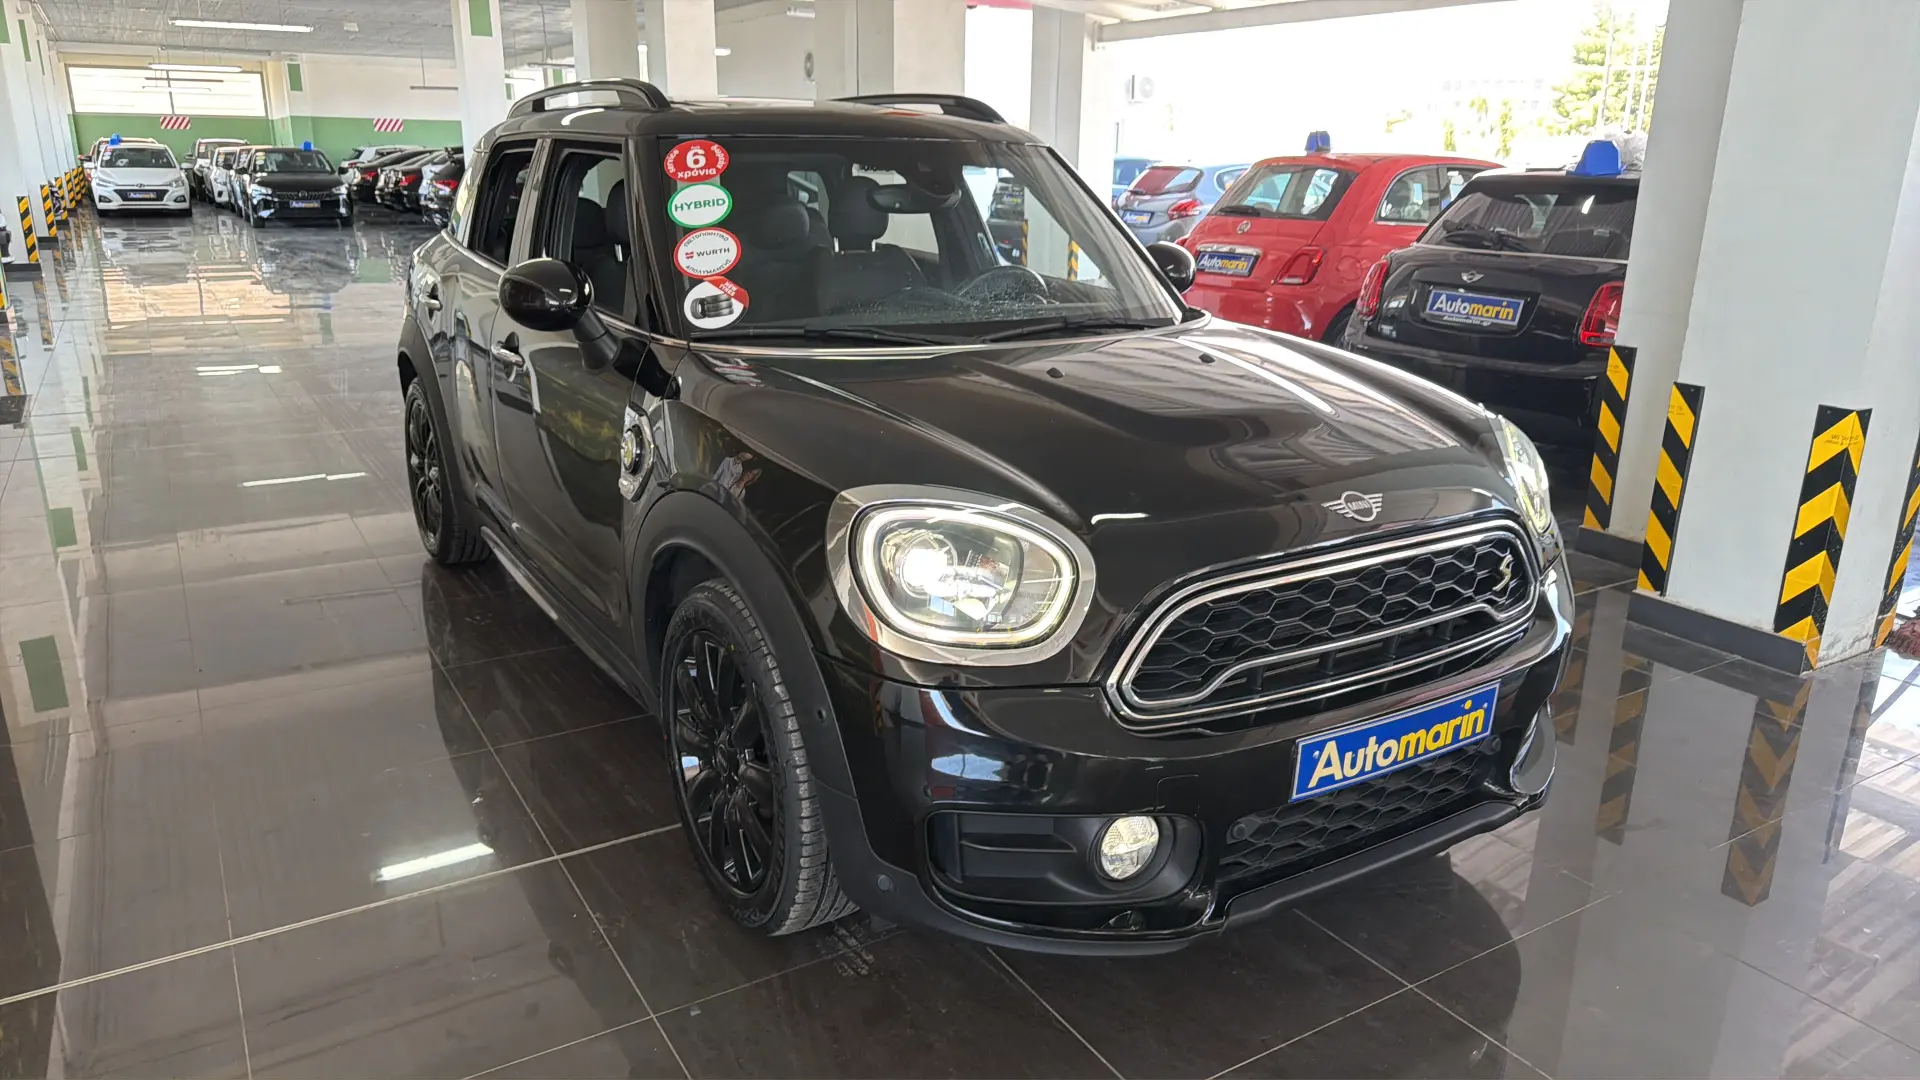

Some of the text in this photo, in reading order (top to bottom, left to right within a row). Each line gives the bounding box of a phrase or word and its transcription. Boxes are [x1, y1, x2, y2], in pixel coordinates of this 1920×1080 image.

[686, 149, 707, 169] 6
[677, 167, 717, 179] χρόνια
[674, 198, 726, 213] HYBRID
[1198, 253, 1249, 270] Automarin
[1432, 293, 1514, 321] Automarin
[1346, 497, 1371, 511] MINI
[1307, 699, 1485, 789] Automarin
